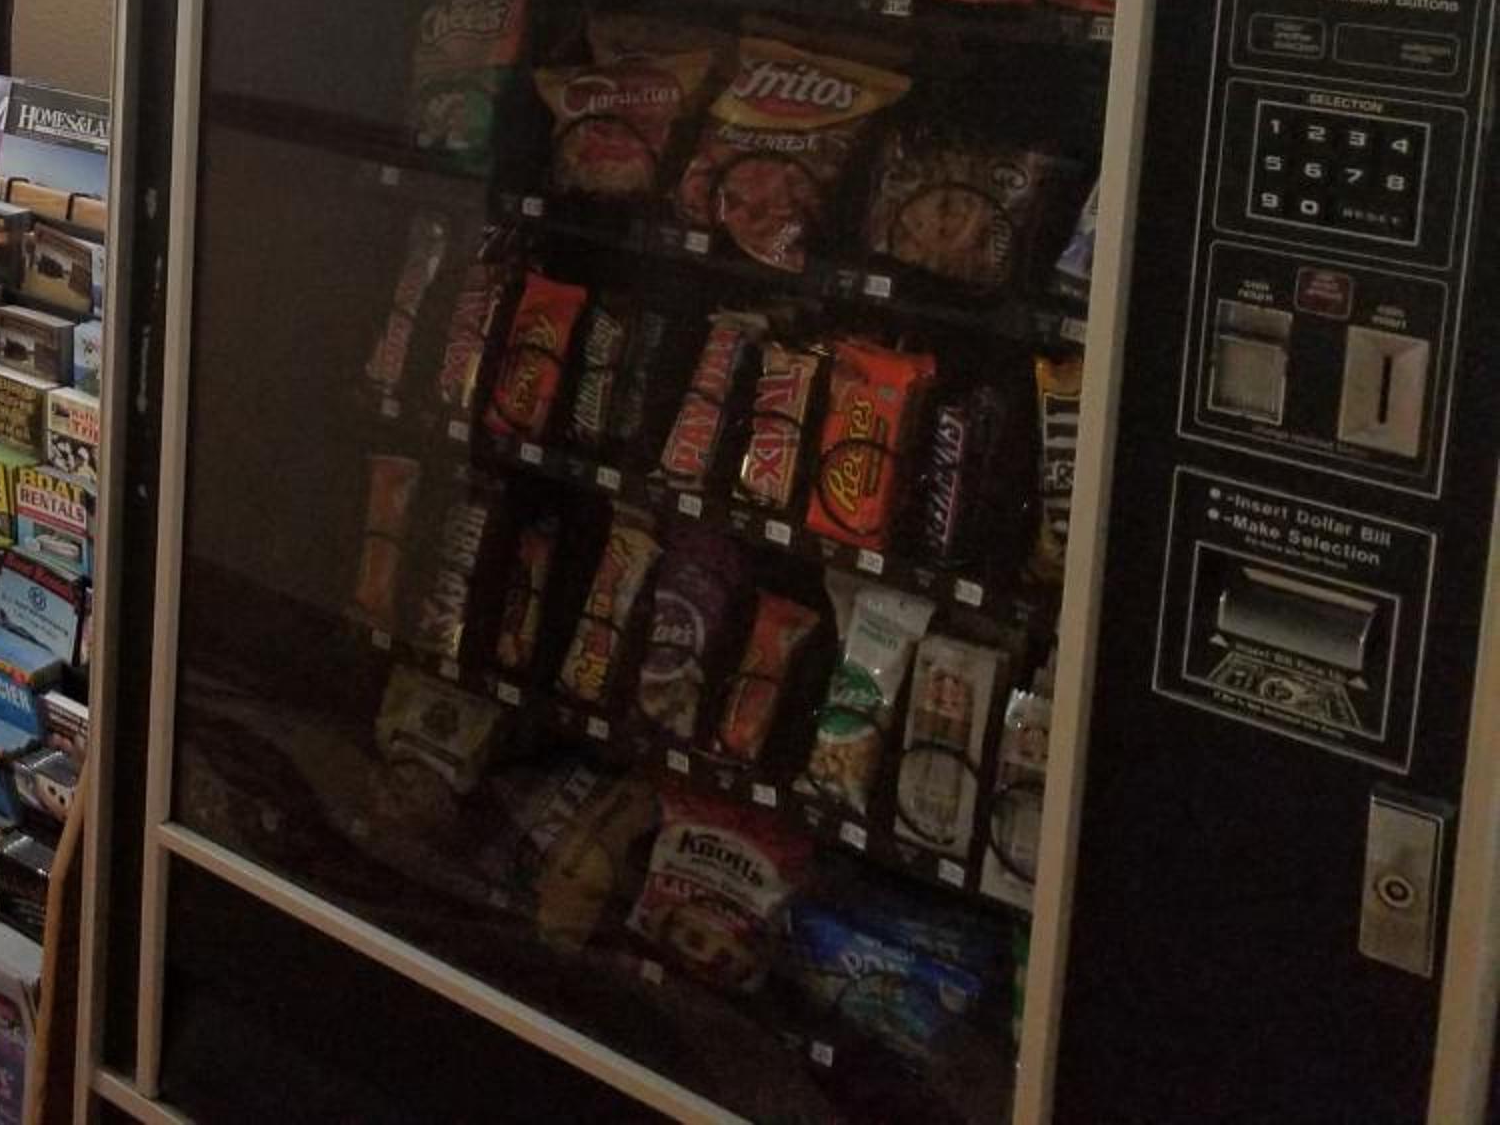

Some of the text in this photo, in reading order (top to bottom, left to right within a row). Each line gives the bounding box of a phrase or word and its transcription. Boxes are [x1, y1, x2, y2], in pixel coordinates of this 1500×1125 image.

[18, 103, 111, 140] HOMES&LA
[1308, 92, 1384, 114] SELECTION
[1269, 118, 1410, 155] 1 2 3 4
[1263, 154, 1406, 193] 5 6 7 8
[1260, 191, 1280, 210] 9
[1299, 198, 1320, 217] 0
[20, 467, 85, 502] BOAT
[19, 487, 85, 524] RENTALS
[1287, 528, 1382, 566] Selection
[1295, 508, 1353, 537] Dollar
[1360, 525, 1392, 549] Bill
